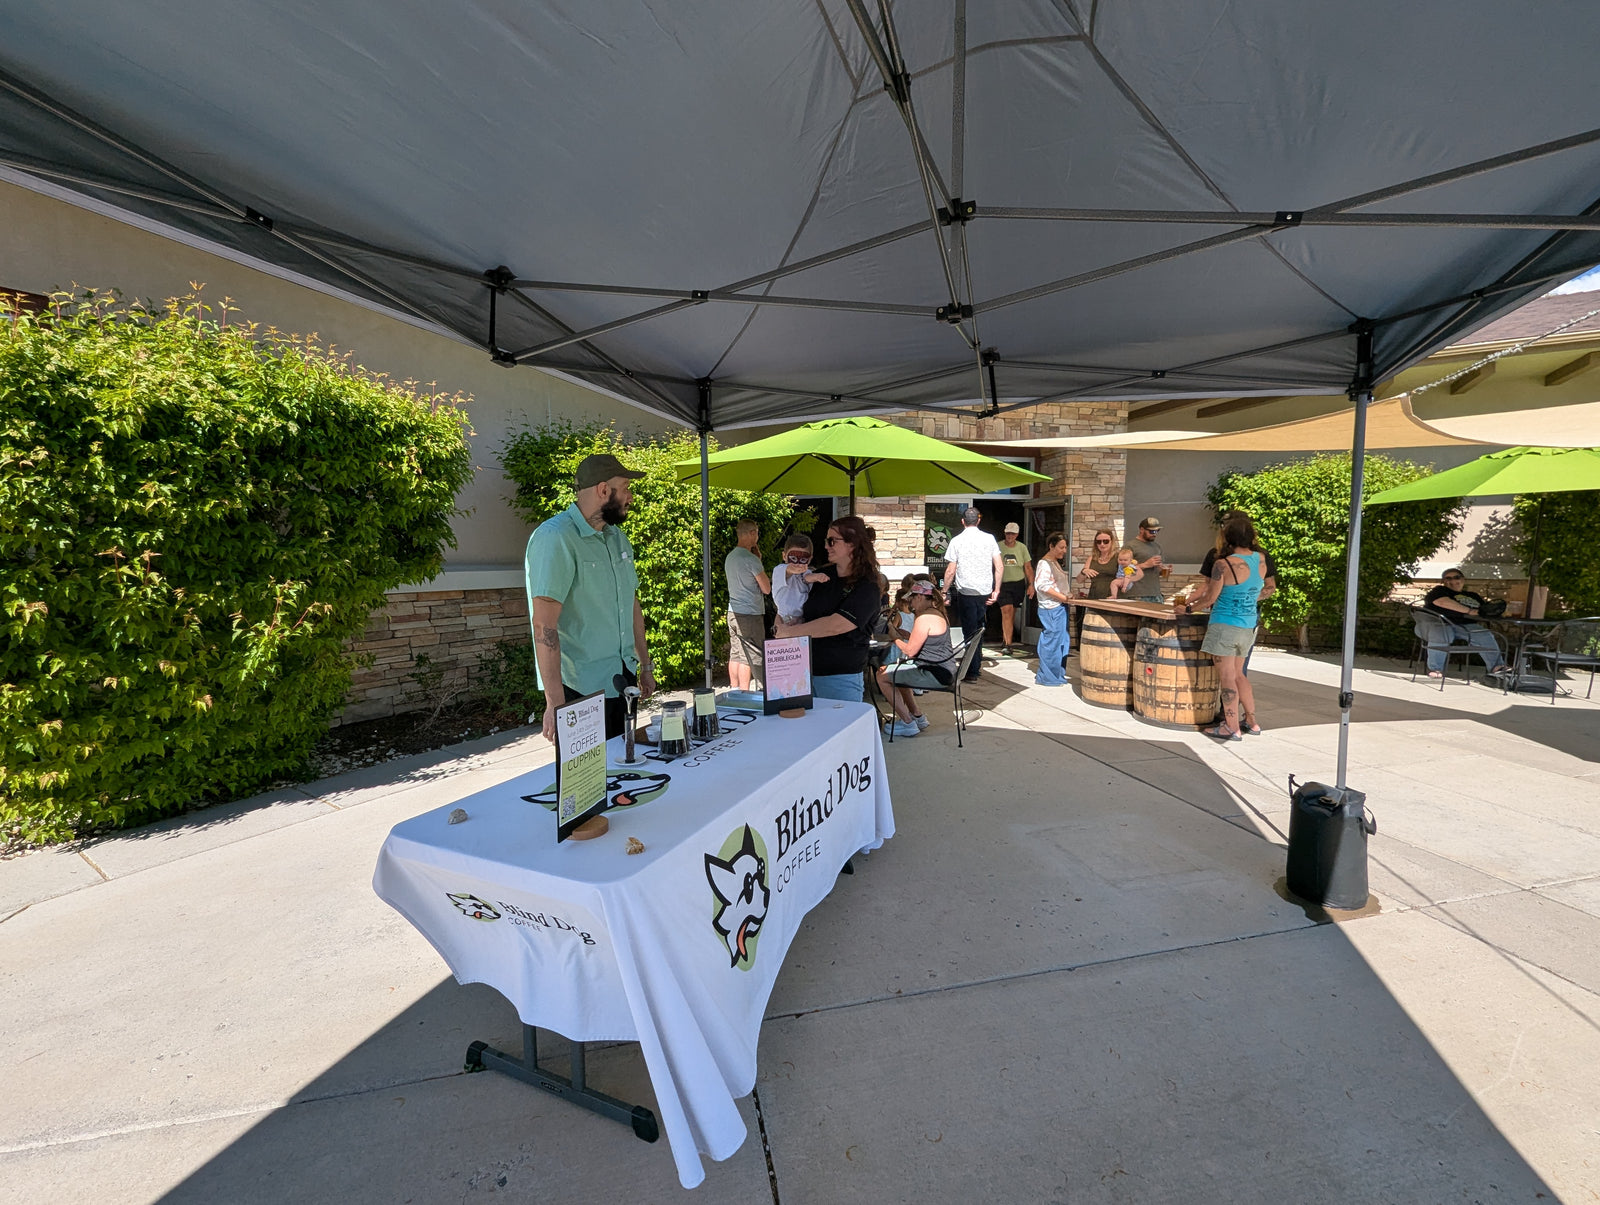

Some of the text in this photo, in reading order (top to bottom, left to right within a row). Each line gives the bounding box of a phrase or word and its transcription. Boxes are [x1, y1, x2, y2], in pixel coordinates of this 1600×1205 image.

[767, 646, 801, 656] NICARAGUA
[767, 654, 802, 664] BUBBLEGUM
[591, 705, 599, 713] Dog
[570, 731, 598, 755] COFFEE
[683, 739, 743, 768] COFFEE
[567, 745, 601, 771] CUPPING
[774, 756, 872, 862] Blind Dog
[776, 839, 821, 893] COFFEE
[496, 900, 596, 945] Blind Dog
[507, 917, 543, 933] COFFEE
